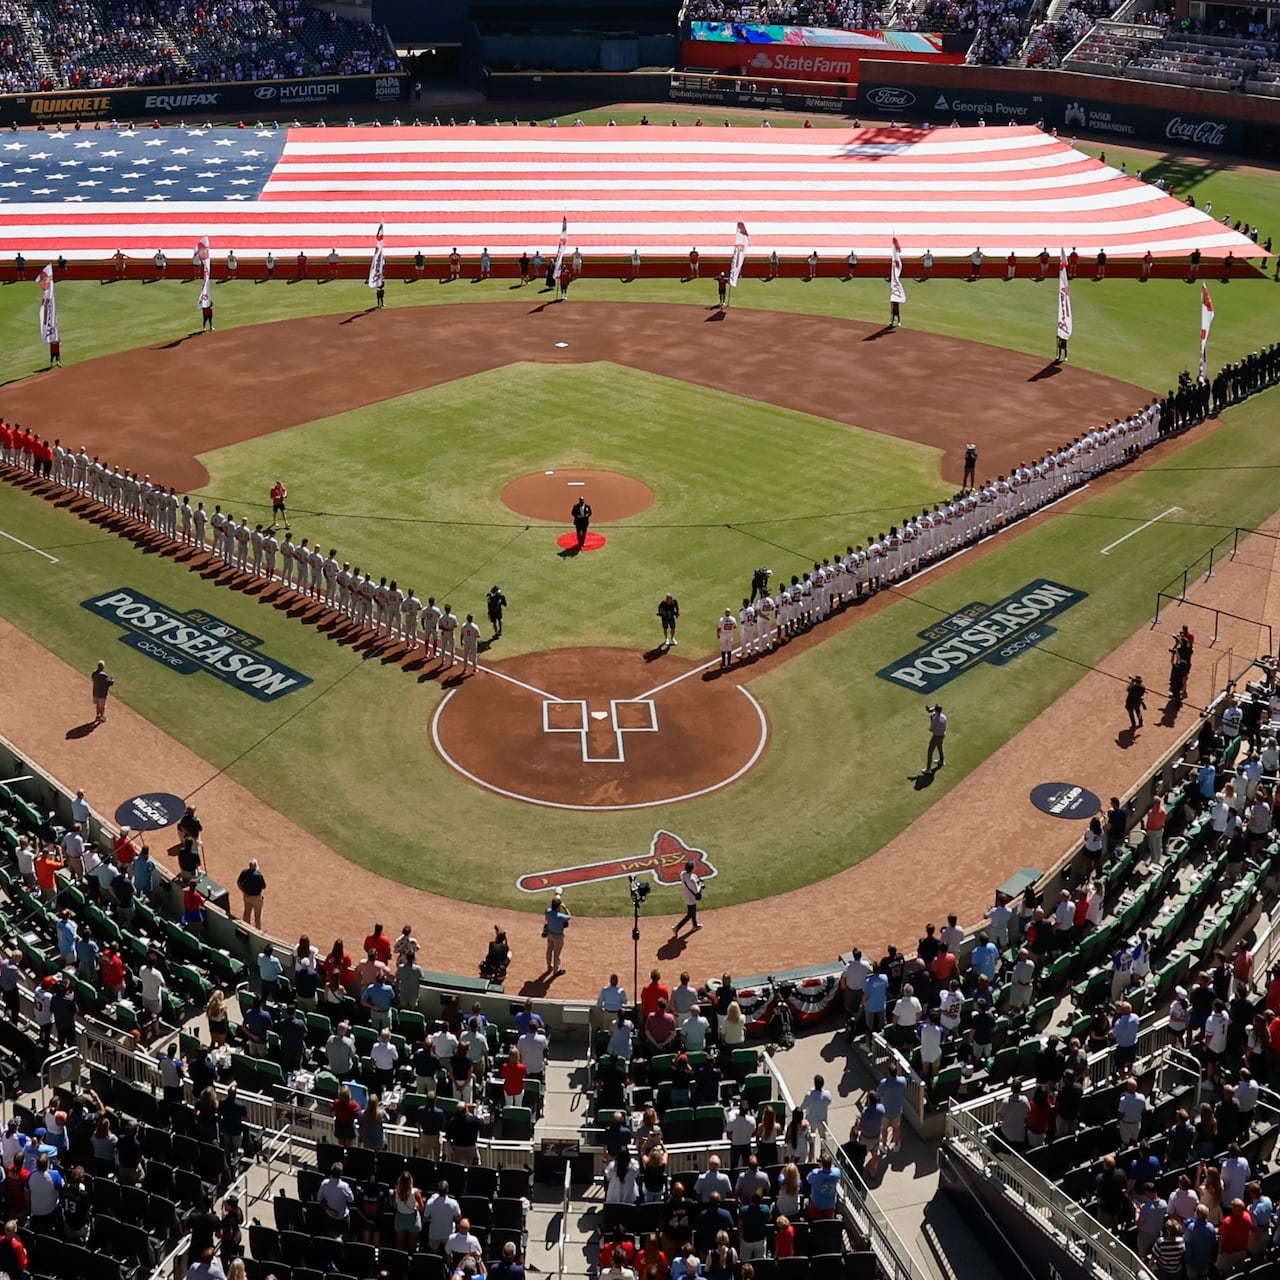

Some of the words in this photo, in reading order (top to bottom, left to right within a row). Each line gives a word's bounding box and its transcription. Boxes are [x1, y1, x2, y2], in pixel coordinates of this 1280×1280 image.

[280, 84, 339, 97] HYUNDAI
[375, 78, 399, 87] PAPA
[375, 86, 400, 96] JOHNS
[874, 89, 907, 105] Ford
[31, 96, 111, 113] QUIKRETE
[145, 93, 218, 110] EQUIFAX
[952, 100, 993, 115] Georgia
[996, 103, 1028, 116] Power
[1089, 111, 1111, 121] KAISER
[1089, 121, 1134, 134] PERMANENTE
[1166, 117, 1228, 145] Coca-Cola
[187, 613, 210, 624] 20
[890, 584, 1074, 687] POSTSEASON
[95, 593, 298, 695] POSTSEASON
[1000, 631, 1040, 657] abbvie
[137, 640, 183, 666] abbvie
[64, 1198, 76, 1213] 13
